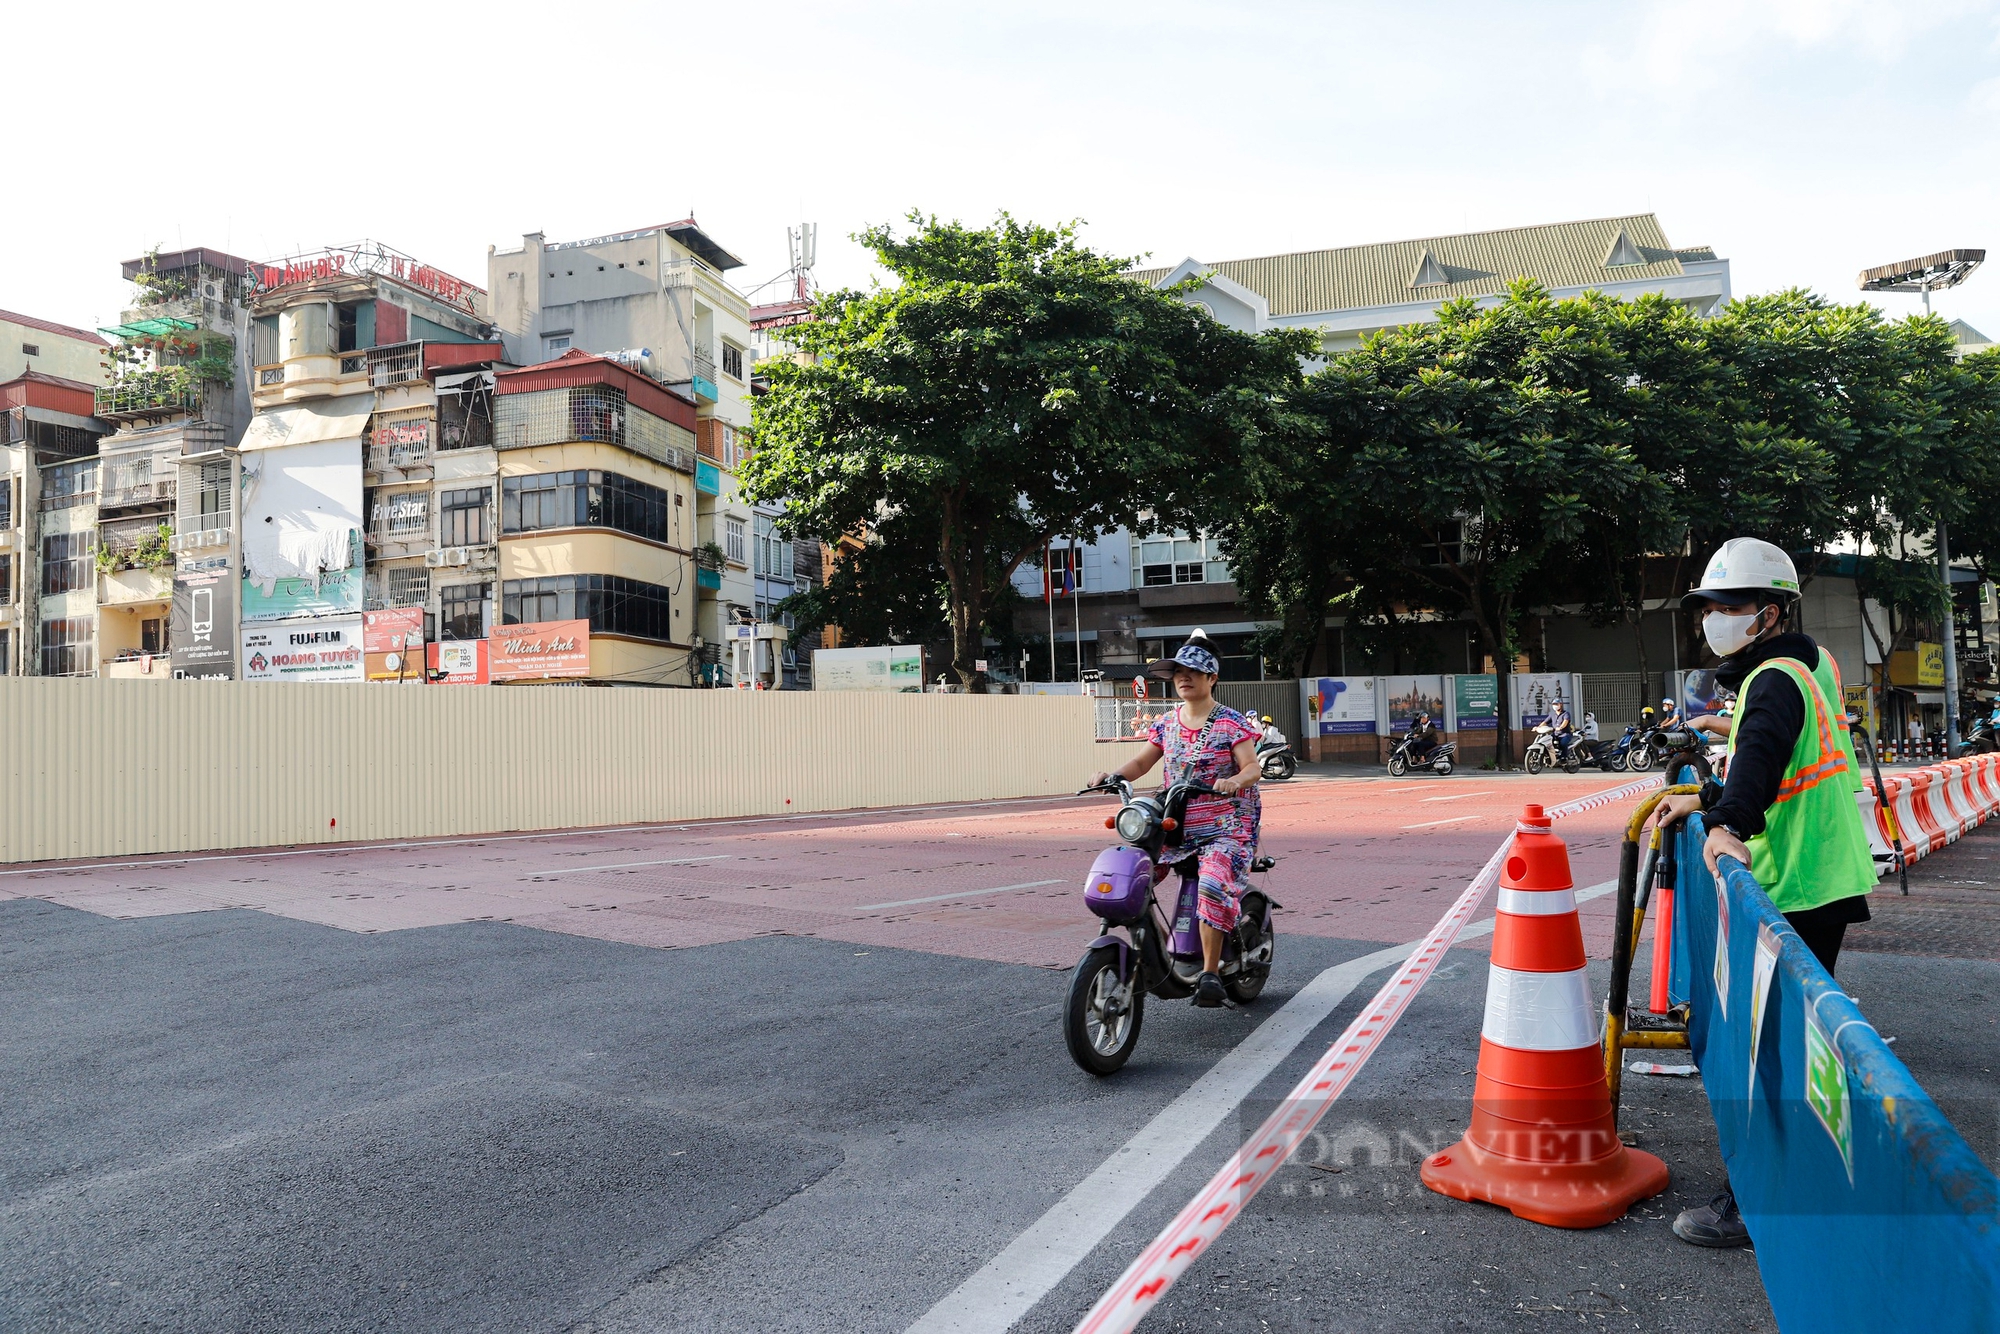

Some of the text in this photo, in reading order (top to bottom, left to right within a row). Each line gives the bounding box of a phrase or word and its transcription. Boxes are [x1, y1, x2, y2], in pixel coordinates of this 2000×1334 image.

[391, 254, 404, 278] IN
[264, 267, 280, 289] IN
[289, 631, 341, 645] FUJIFILM
[503, 635, 575, 655] Minh Anh
